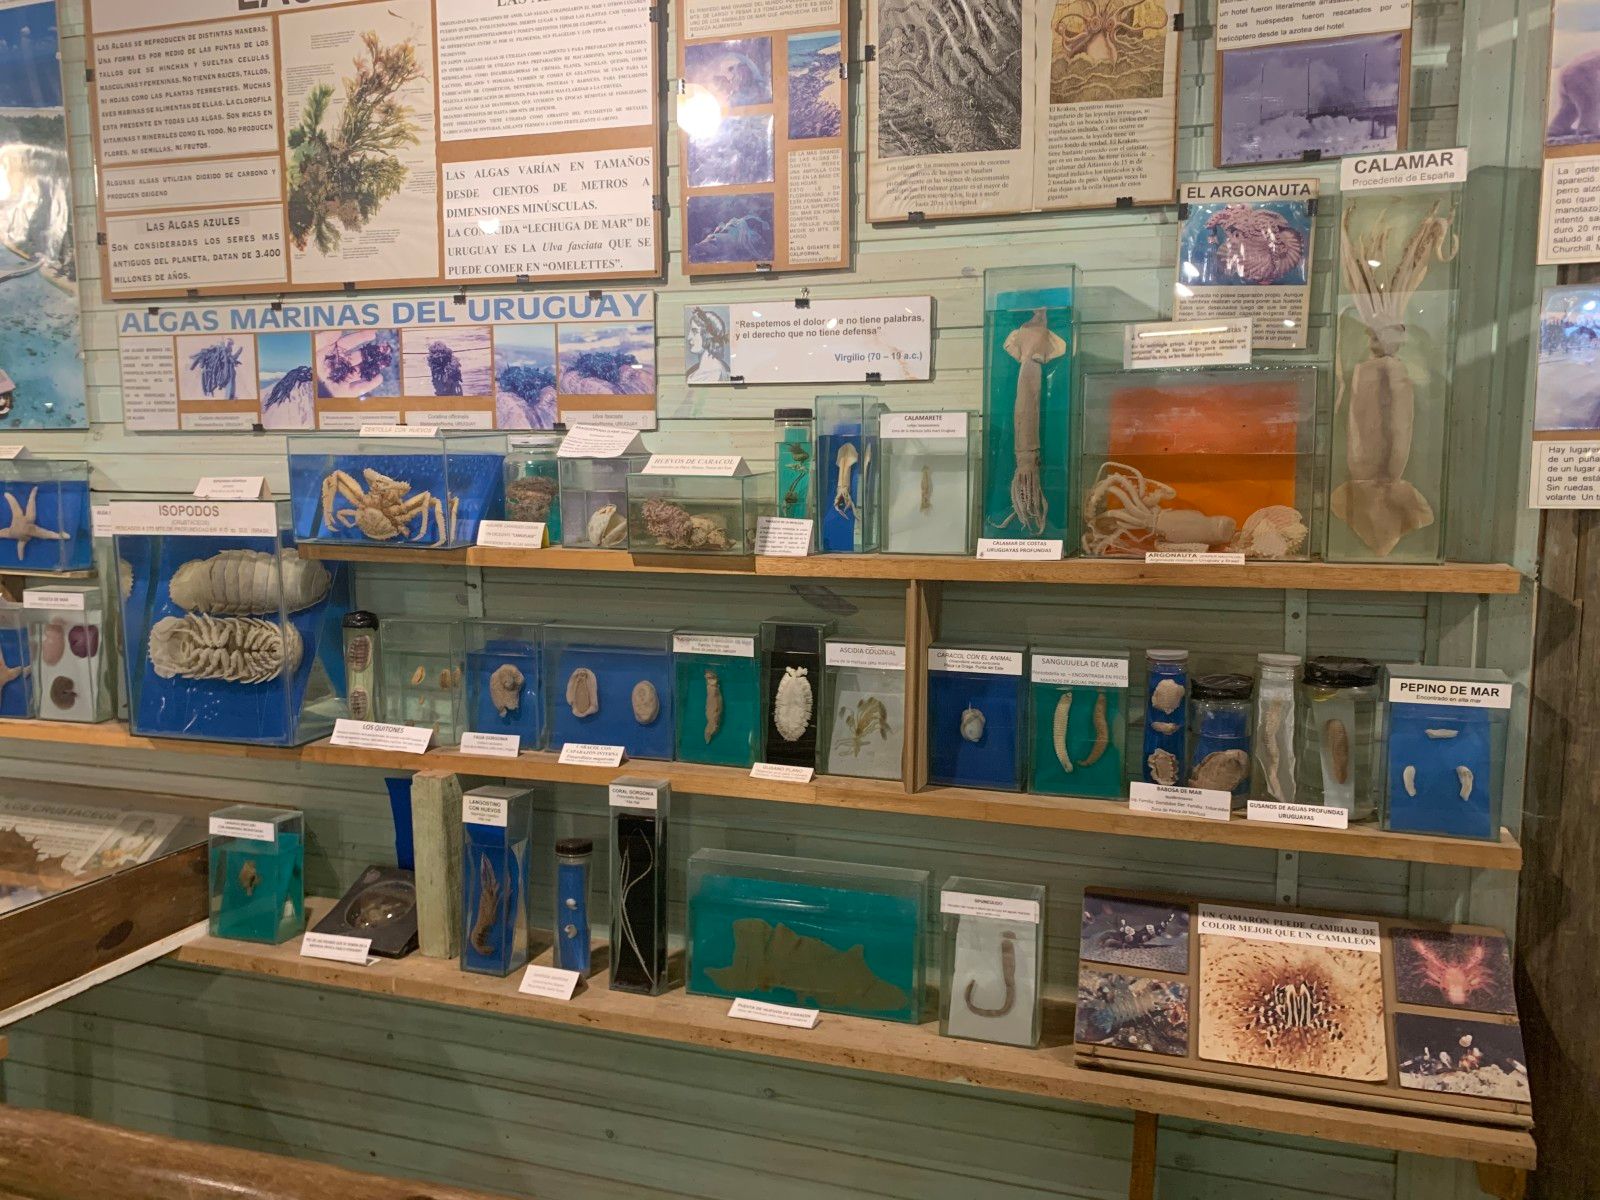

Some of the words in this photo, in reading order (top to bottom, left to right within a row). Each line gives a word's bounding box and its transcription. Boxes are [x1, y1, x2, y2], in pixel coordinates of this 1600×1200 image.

[446, 169, 466, 181] LAS
[474, 166, 510, 179] ALGAS
[518, 162, 560, 176] VARÍAN
[570, 160, 584, 172] EN
[595, 156, 650, 170] TAMAÑOS
[1354, 152, 1454, 174] CALAMAR
[1575, 166, 1600, 175] gente
[1352, 174, 1403, 187] Procedente
[1406, 173, 1417, 184] de
[1420, 170, 1455, 183] España
[446, 188, 479, 200] DESDE
[492, 184, 539, 197] CIENTOS
[553, 183, 567, 193] DE
[581, 179, 628, 191] METROS
[642, 178, 650, 187] A
[1187, 186, 1206, 199] EL
[1210, 183, 1311, 198] ARGONAUTA
[446, 204, 520, 218] DIMENSIONES
[522, 200, 597, 214] MINÚSCULAS.
[146, 221, 165, 232] LAS
[168, 219, 200, 230] ALGAS
[203, 216, 240, 228] AZULES
[447, 227, 460, 238] LA
[584, 220, 598, 230] DE
[636, 217, 650, 228] DE
[112, 242, 128, 252] SON
[134, 238, 198, 250] CONSIDERADAS
[204, 236, 220, 245] LOS
[227, 234, 255, 244] SERES
[447, 245, 497, 257] URUGUAY
[504, 244, 517, 254] ES
[522, 243, 536, 253] LA
[542, 242, 563, 252] Ulva
[568, 240, 603, 251] fasciata
[608, 238, 631, 249] QUE
[637, 237, 651, 248] SE
[113, 258, 151, 268] ANTIGUOS
[154, 256, 169, 265] DEL
[212, 252, 239, 261] DATAN
[241, 250, 252, 259] DE
[255, 248, 281, 258] 3.400
[448, 264, 482, 275] PUEDE
[484, 263, 523, 274] COMER
[526, 262, 540, 272] EN
[114, 274, 152, 283] MILLONES
[154, 273, 165, 281] DE
[121, 309, 218, 333] ALGAS
[231, 303, 379, 329] MARINAS
[393, 301, 455, 324] DEL
[468, 294, 647, 322] URUGUAY
[793, 318, 801, 327] el
[803, 317, 826, 327] dolor
[846, 316, 858, 326] no
[859, 315, 881, 326] tiene
[735, 330, 741, 340] y
[742, 330, 751, 340] el
[751, 329, 787, 340] derecho
[787, 328, 804, 339] que
[805, 328, 818, 338] no
[818, 328, 841, 338] tiene
[834, 352, 865, 364] Virgilio
[867, 352, 881, 363] (70
[892, 352, 902, 362] 19
[903, 351, 923, 362] a.c.)
[159, 505, 220, 517] ISOPODOS
[1090, 660, 1100, 668] DE
[1101, 661, 1119, 669] MAR
[1400, 682, 1446, 694] PEPINO
[1450, 685, 1467, 695] DE
[1470, 686, 1500, 697] MAR
[1249, 803, 1278, 811] GUSANOS
[1286, 805, 1308, 813] AGUAS
[1308, 807, 1344, 816] PROFUNDAS
[1278, 813, 1314, 821] URUGUAYAS
[1202, 920, 1236, 932] COLOR
[1238, 924, 1273, 935] MEJOR
[1274, 928, 1296, 938] QUE
[1298, 930, 1313, 940] UN
[1317, 932, 1377, 946] CAMALEÓN
[1274, 919, 1305, 928] PUEDE
[1310, 923, 1358, 934] CAMBIAR
[1362, 928, 1376, 936] DE
